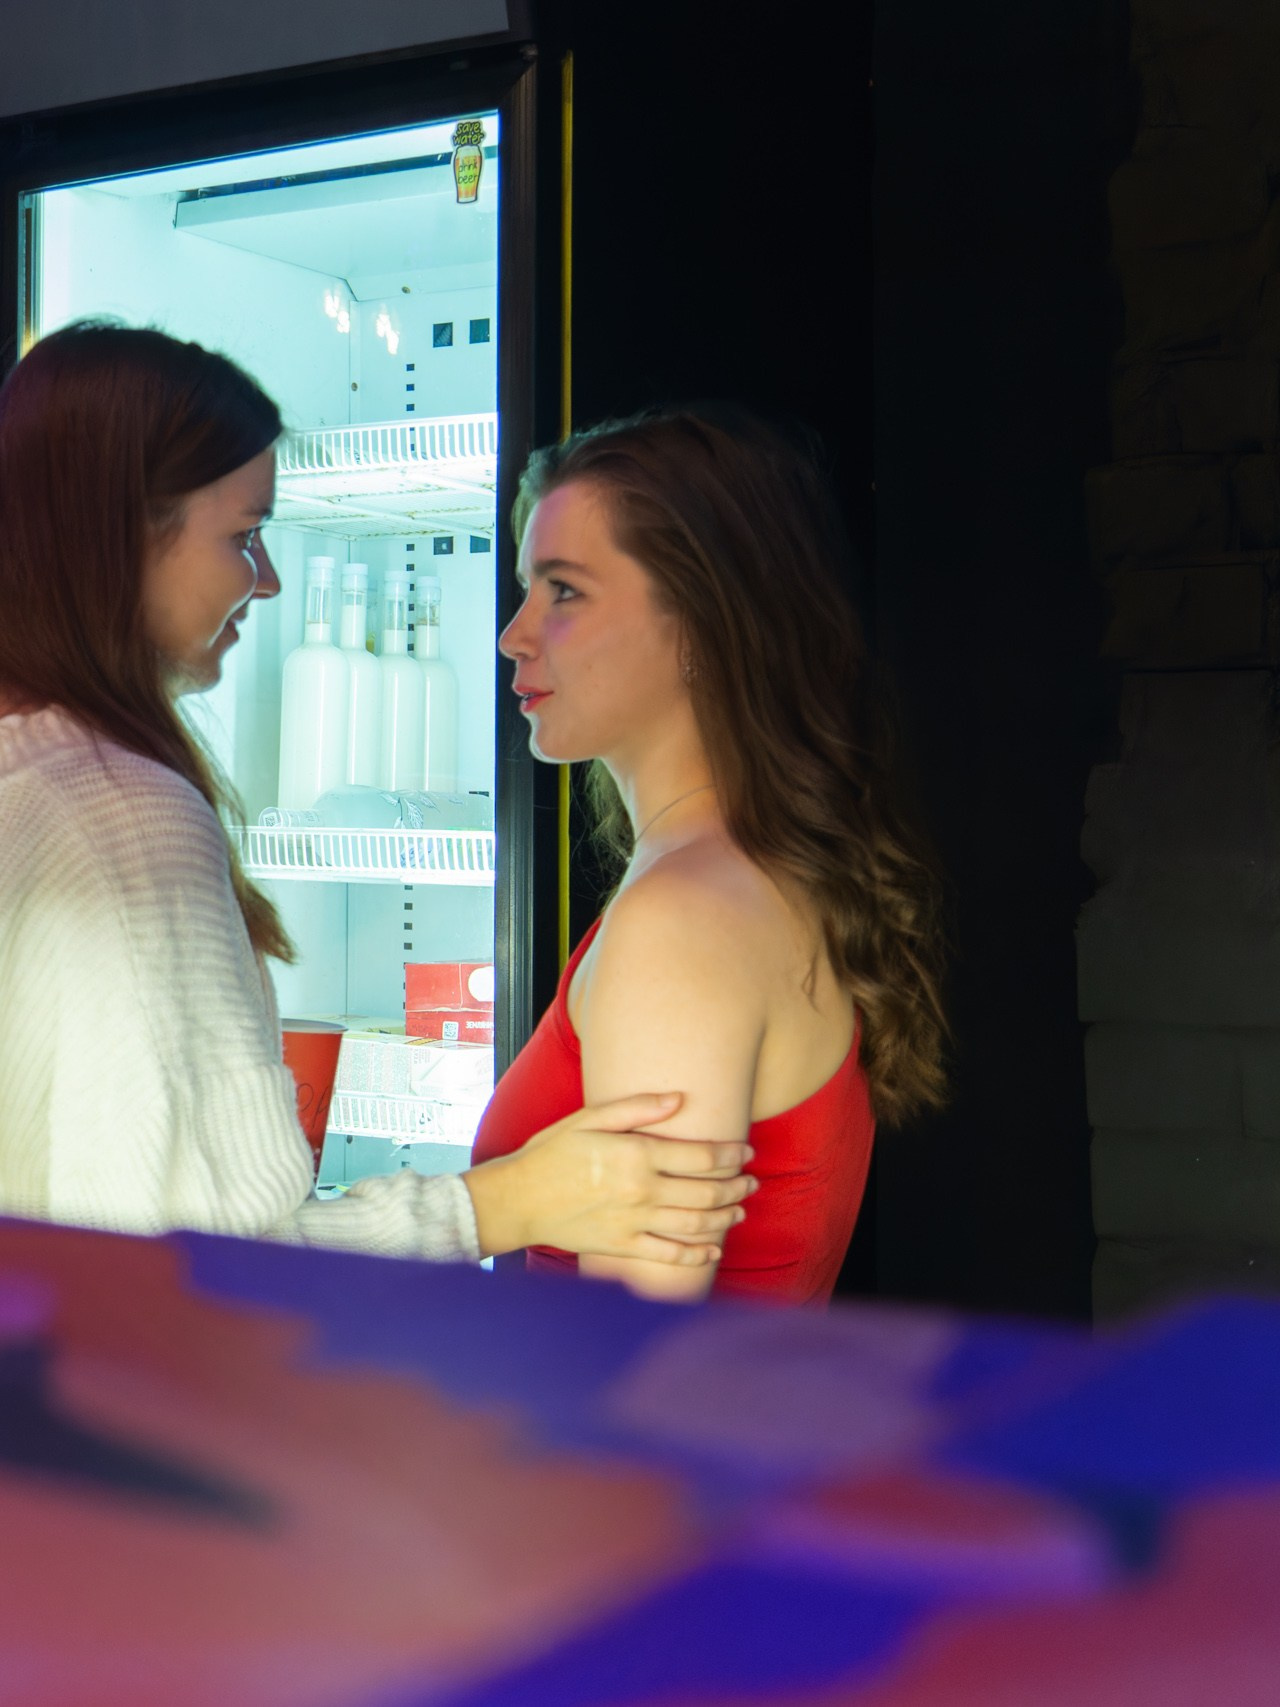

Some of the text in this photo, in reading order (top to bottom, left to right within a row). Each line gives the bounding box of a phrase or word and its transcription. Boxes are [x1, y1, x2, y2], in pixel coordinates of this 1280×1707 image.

[456, 122, 481, 134] save
[453, 132, 484, 146] water
[458, 159, 478, 172] drink
[457, 173, 478, 184] beer
